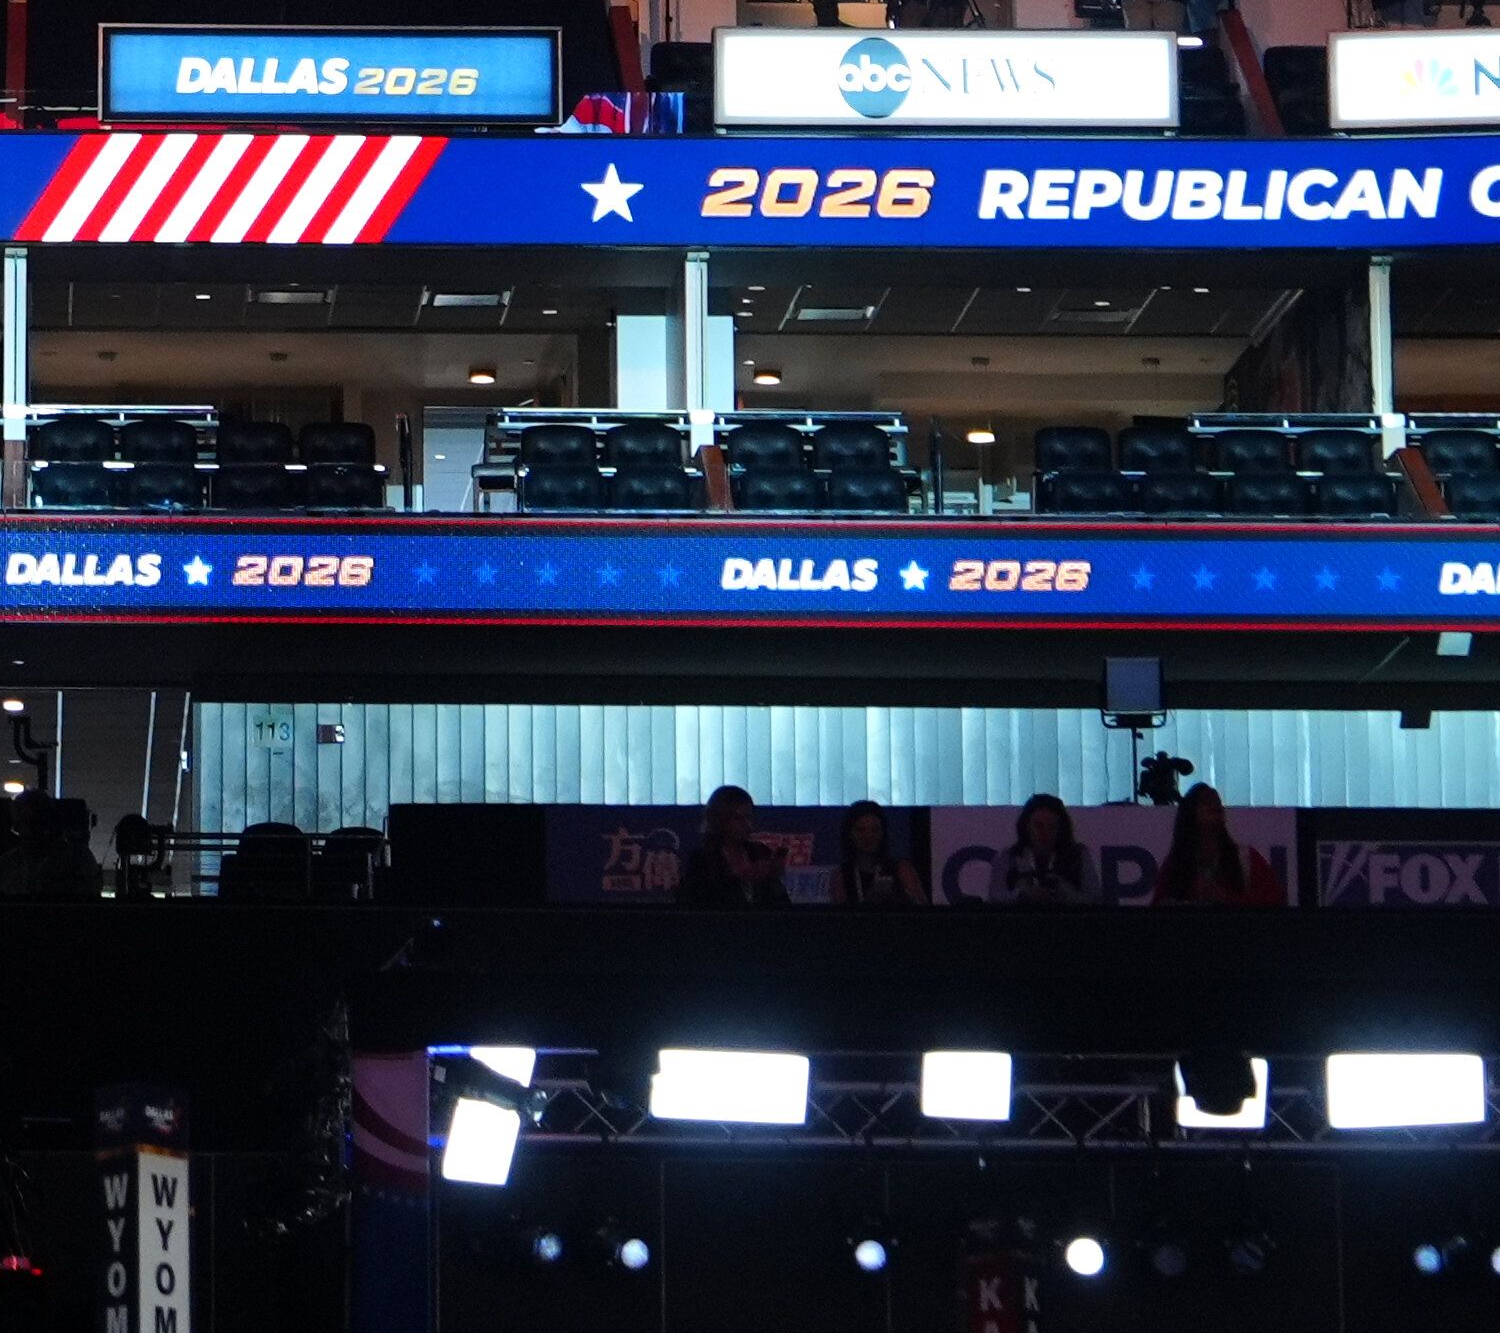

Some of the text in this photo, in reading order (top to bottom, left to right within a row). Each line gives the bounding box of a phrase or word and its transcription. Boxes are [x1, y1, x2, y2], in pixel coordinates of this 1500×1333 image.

[176, 57, 479, 96] DALLAS 2026
[838, 53, 1058, 94] abc NEWS
[700, 169, 936, 218] 2026
[979, 168, 1443, 220] REPUBLICAN
[6, 553, 373, 587] DALLAS 2026
[721, 559, 1091, 591] DALLAS 2026
[256, 722, 290, 741] 113
[1369, 851, 1489, 905] FOX
